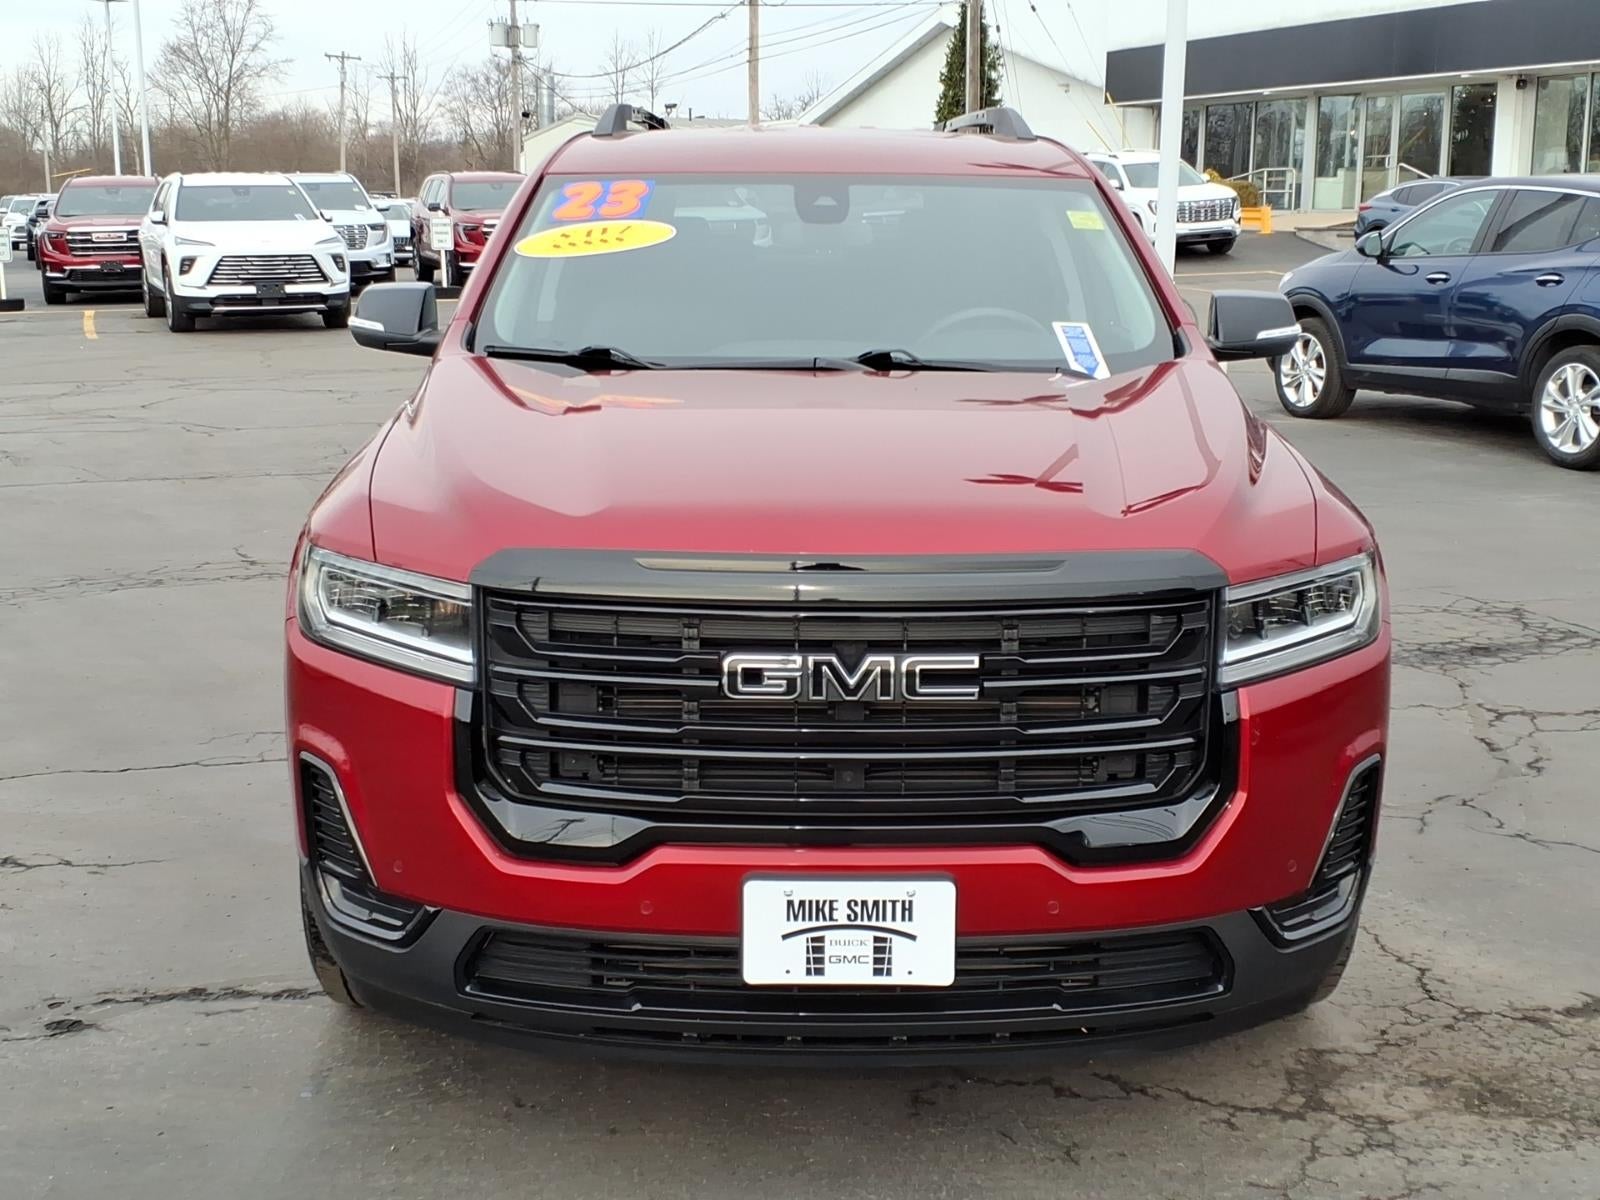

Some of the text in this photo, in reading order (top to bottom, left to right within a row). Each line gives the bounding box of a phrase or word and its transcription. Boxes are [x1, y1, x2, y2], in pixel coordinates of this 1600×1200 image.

[552, 180, 649, 221] 23
[722, 654, 981, 701] GMC
[786, 899, 914, 922] MIKE SMITH
[829, 938, 870, 947] BUICK
[828, 954, 871, 965] GMC
